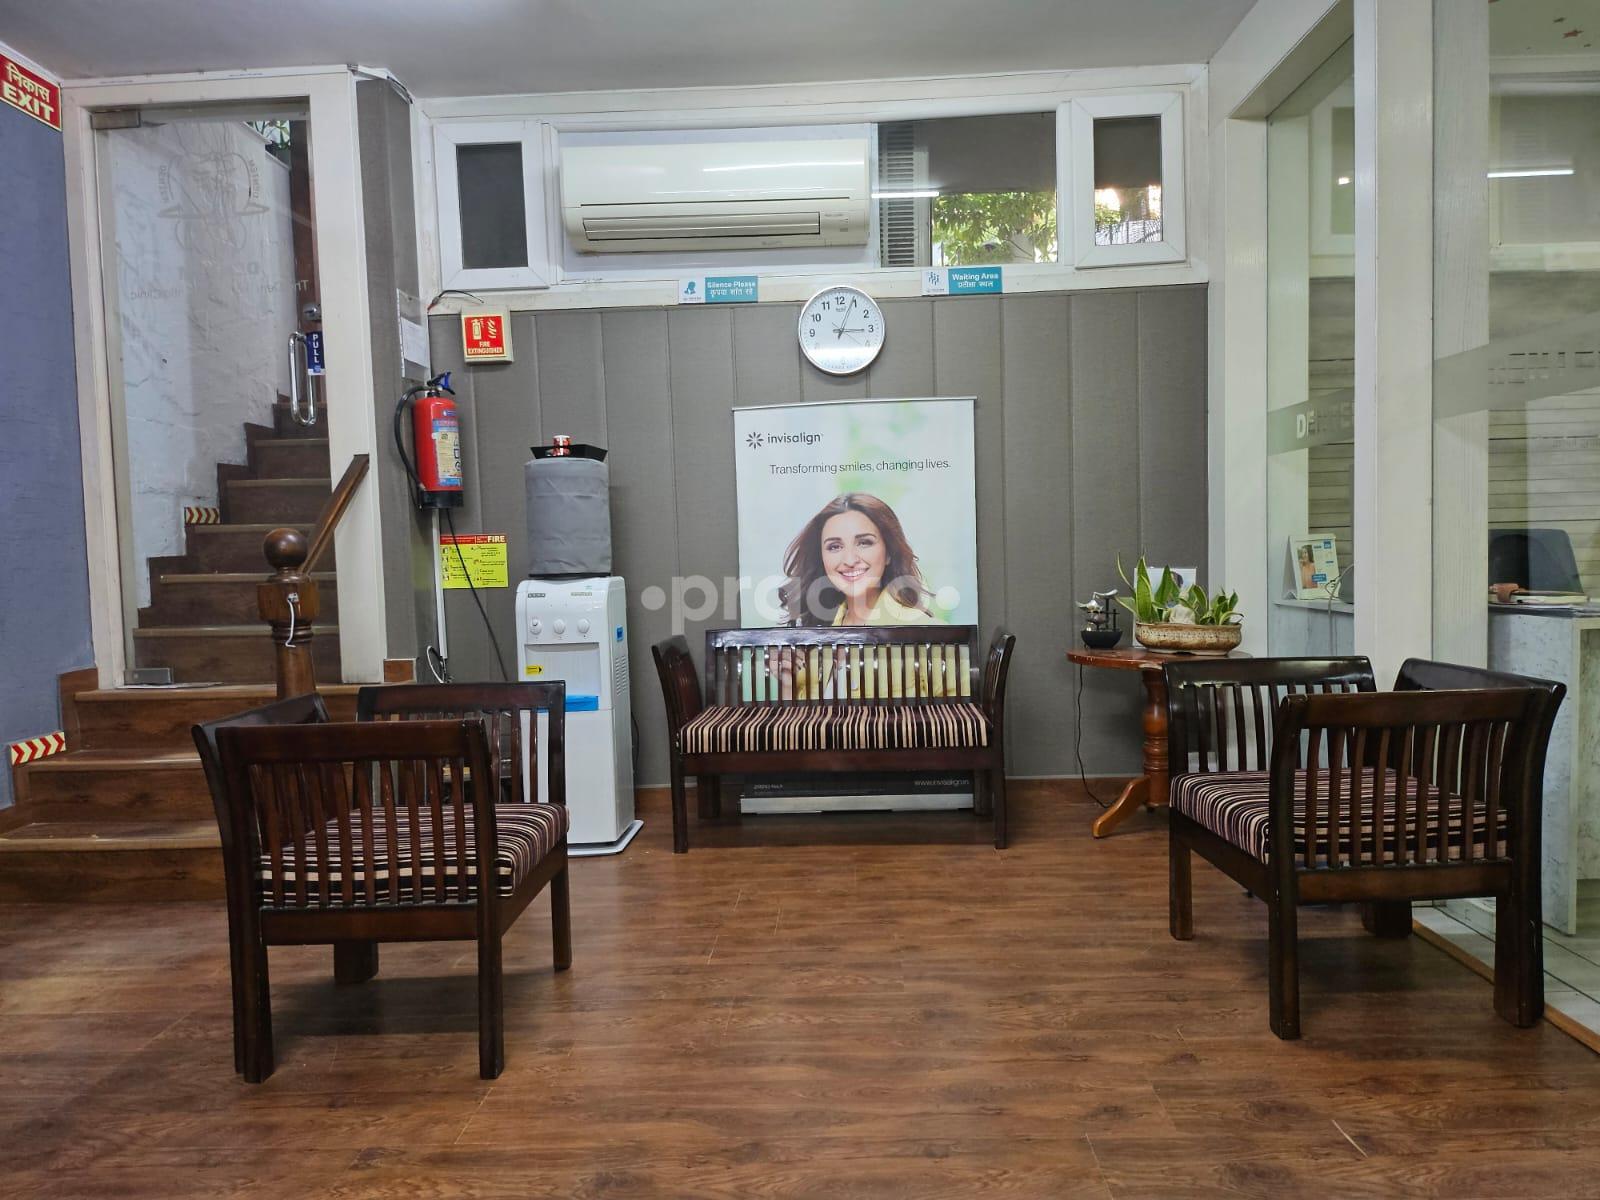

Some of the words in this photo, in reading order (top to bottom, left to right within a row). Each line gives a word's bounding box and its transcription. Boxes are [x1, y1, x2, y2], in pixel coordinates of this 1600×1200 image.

[5, 62, 50, 104] निकास
[3, 80, 54, 121] EXIT
[951, 273, 980, 281] Waiting
[981, 272, 999, 280] Area
[733, 280, 756, 288] Please
[835, 296, 845, 305] 12
[821, 301, 830, 310] 11
[811, 313, 821, 322] 10
[863, 309, 869, 319] 2
[809, 328, 816, 337] 9
[867, 324, 874, 333] 3
[312, 333, 320, 364] PULL
[767, 432, 821, 445] invisalign
[769, 463, 838, 475] Transforming
[839, 460, 875, 473] smiles,
[876, 458, 924, 472] changing
[925, 458, 951, 469] lives.
[487, 535, 506, 543] FIRE
